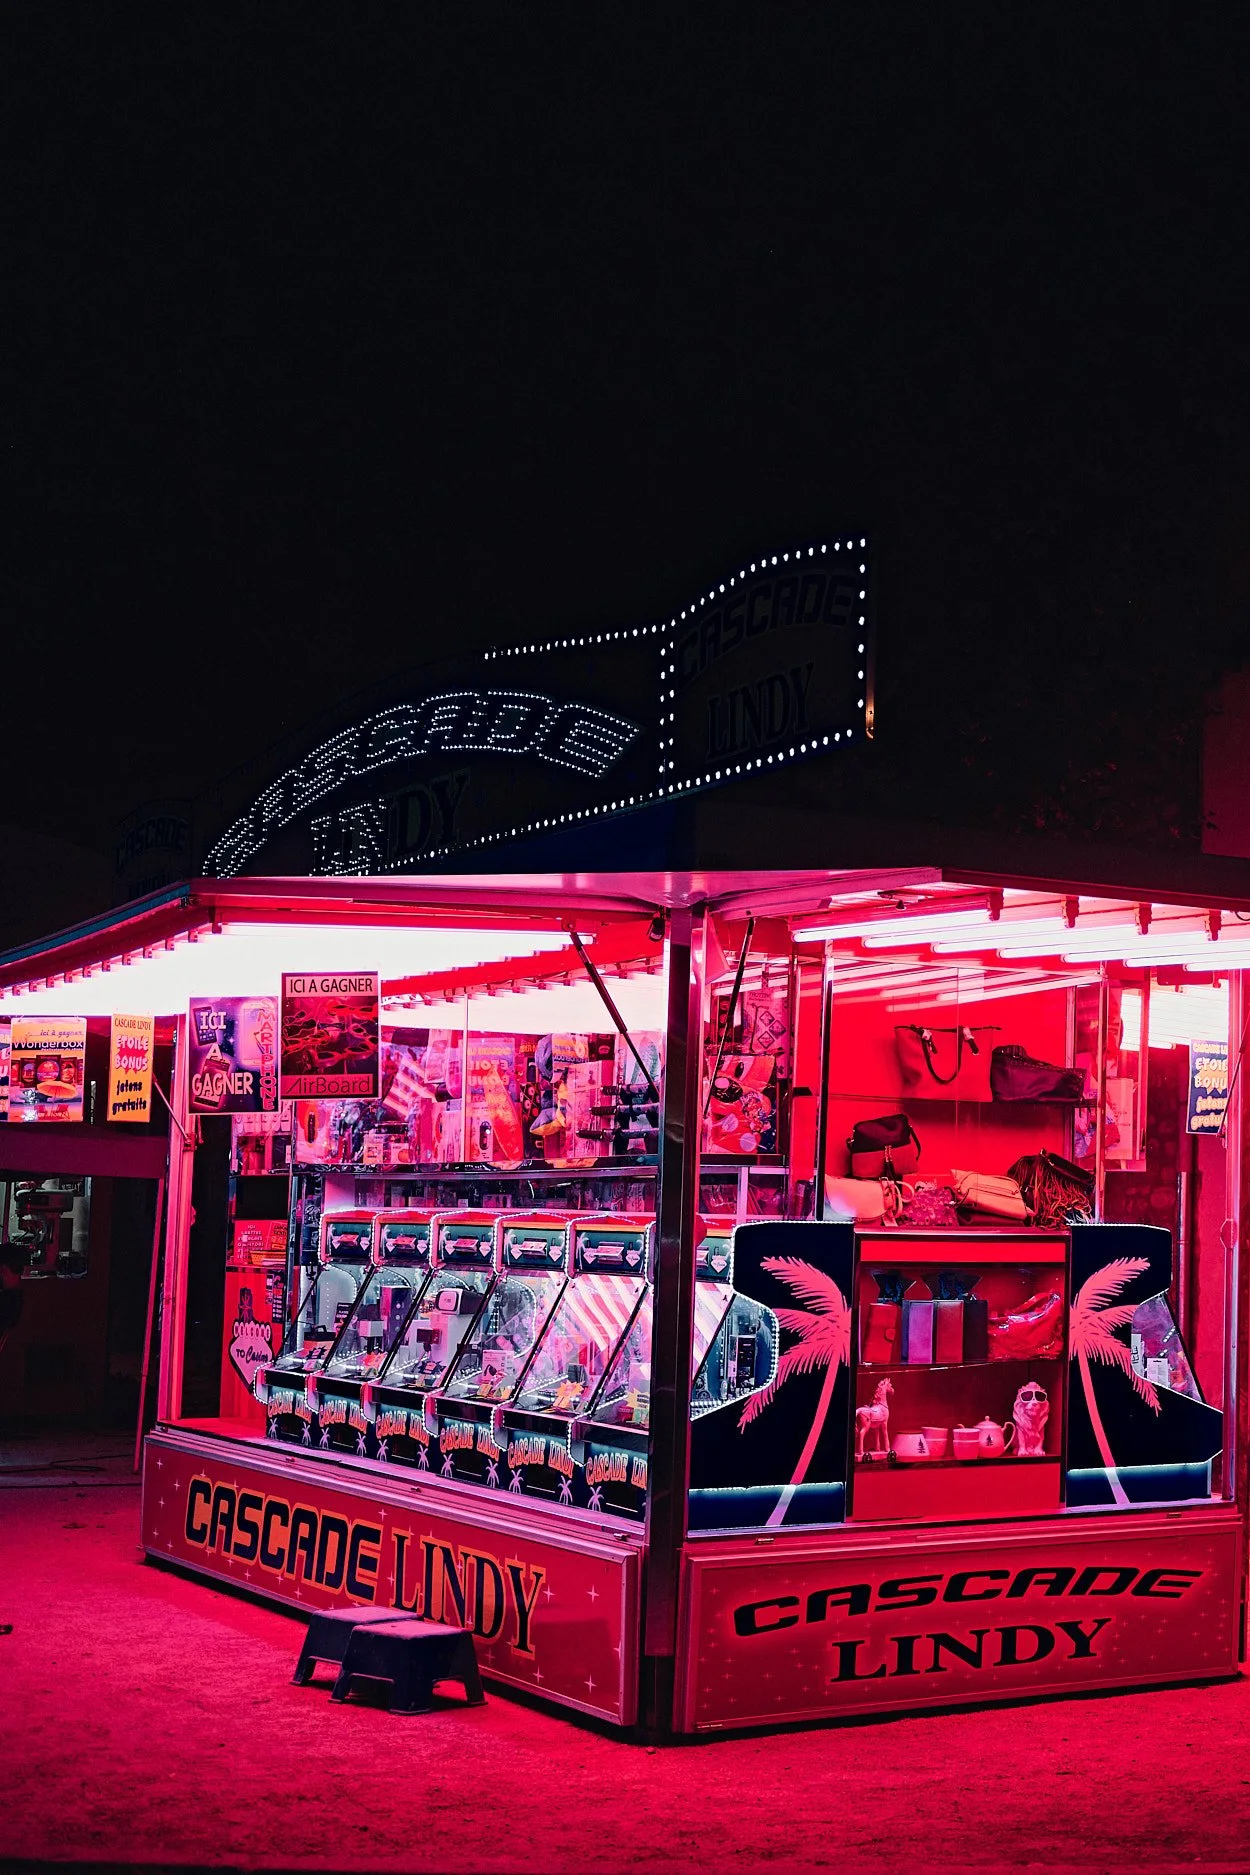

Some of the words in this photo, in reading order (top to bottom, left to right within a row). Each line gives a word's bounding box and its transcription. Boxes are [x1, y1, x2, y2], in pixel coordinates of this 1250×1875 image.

[677, 571, 856, 690] CASCADE
[706, 662, 815, 760] LINDY
[202, 691, 641, 877] CASCADE
[289, 978, 306, 993] ICI
[308, 978, 318, 993] A
[320, 978, 373, 993] GAGNER
[115, 1018, 137, 1029] CASCADE
[200, 1011, 227, 1031] ICI
[13, 1040, 83, 1049] Wonderbox
[116, 1034, 149, 1051] ETOILE
[206, 1043, 223, 1061] A
[257, 999, 277, 1111] SMARTPHONE
[115, 1055, 149, 1071] BONUS
[192, 1071, 254, 1097] GAGNER
[286, 1075, 371, 1095] AirBoard
[234, 1324, 270, 1339] WELCOME
[236, 1348, 246, 1358] TO
[267, 1391, 294, 1418] CASCADE
[319, 1400, 348, 1428] CASCADE
[375, 1409, 407, 1440] CASCADE
[439, 1422, 475, 1453] CASCADE
[507, 1437, 546, 1469] CASCADE
[585, 1451, 629, 1486] CASCADE
[184, 1476, 384, 1604] CASCADE
[391, 1527, 546, 1660] LINDY
[732, 1566, 1204, 1638] CASCADE
[829, 1617, 1112, 1683] LINDY
